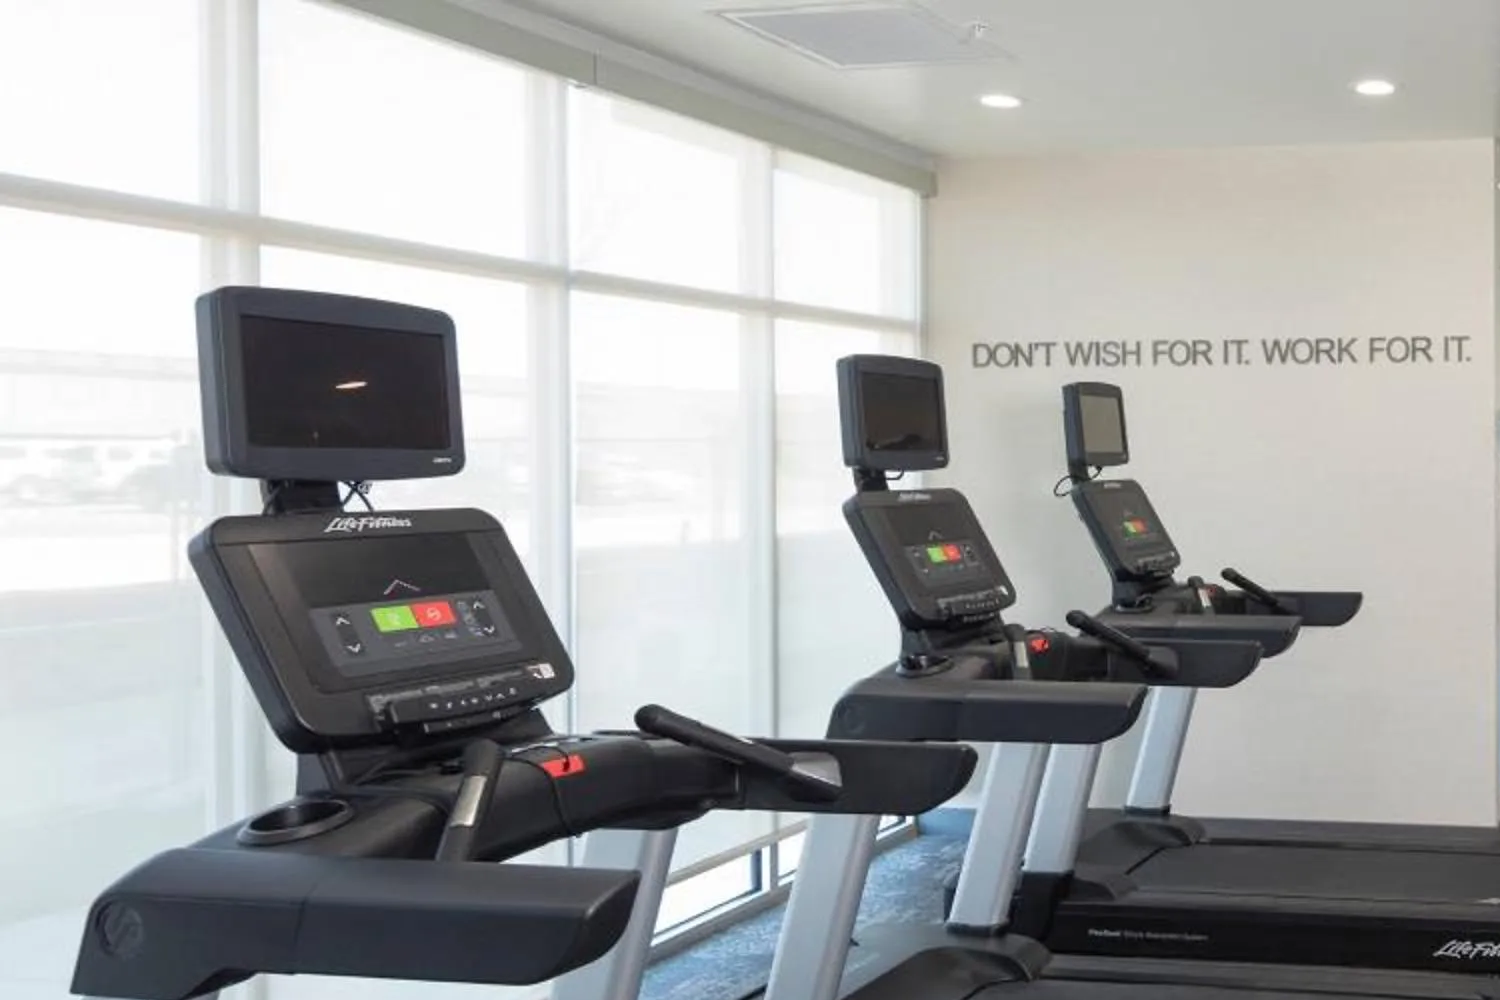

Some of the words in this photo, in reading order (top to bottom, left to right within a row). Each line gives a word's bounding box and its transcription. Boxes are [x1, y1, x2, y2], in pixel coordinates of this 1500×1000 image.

[971, 341, 1057, 368] DON'T
[1064, 340, 1142, 367] WISH
[1152, 339, 1213, 367] FOR
[1222, 338, 1250, 365] IT.
[1261, 337, 1358, 365] WORK
[1368, 335, 1434, 364] FOR
[1443, 335, 1472, 363] IT.
